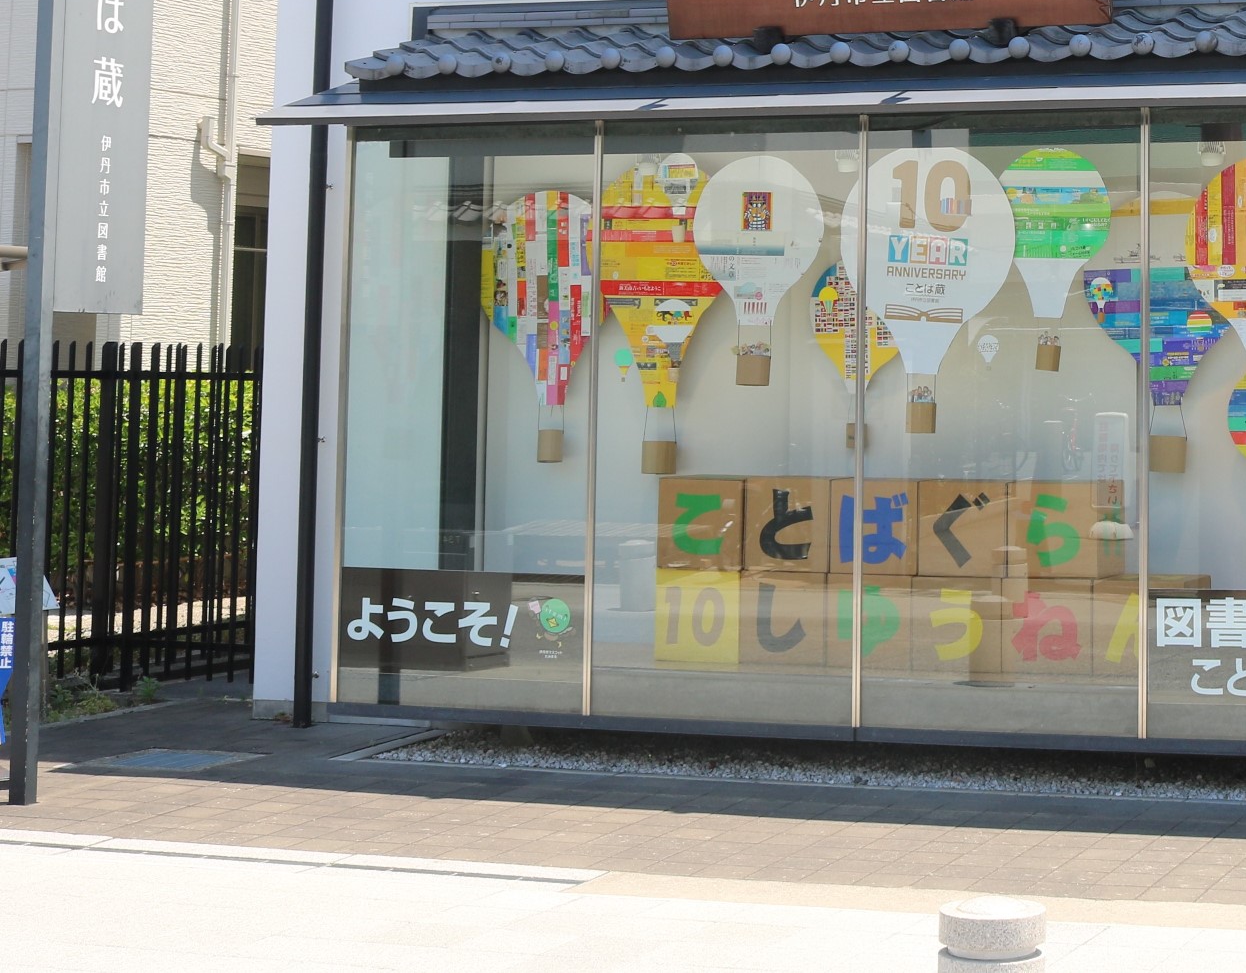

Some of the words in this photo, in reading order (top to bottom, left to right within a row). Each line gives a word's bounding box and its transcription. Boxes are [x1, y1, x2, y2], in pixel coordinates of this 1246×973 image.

[95, 134, 112, 283] 伊丹市立図書館
[892, 159, 971, 233] 10
[886, 265, 967, 281] ANNIVERSARY
[888, 234, 969, 266] YEAR
[0, 621, 15, 669] 駐輪禁止
